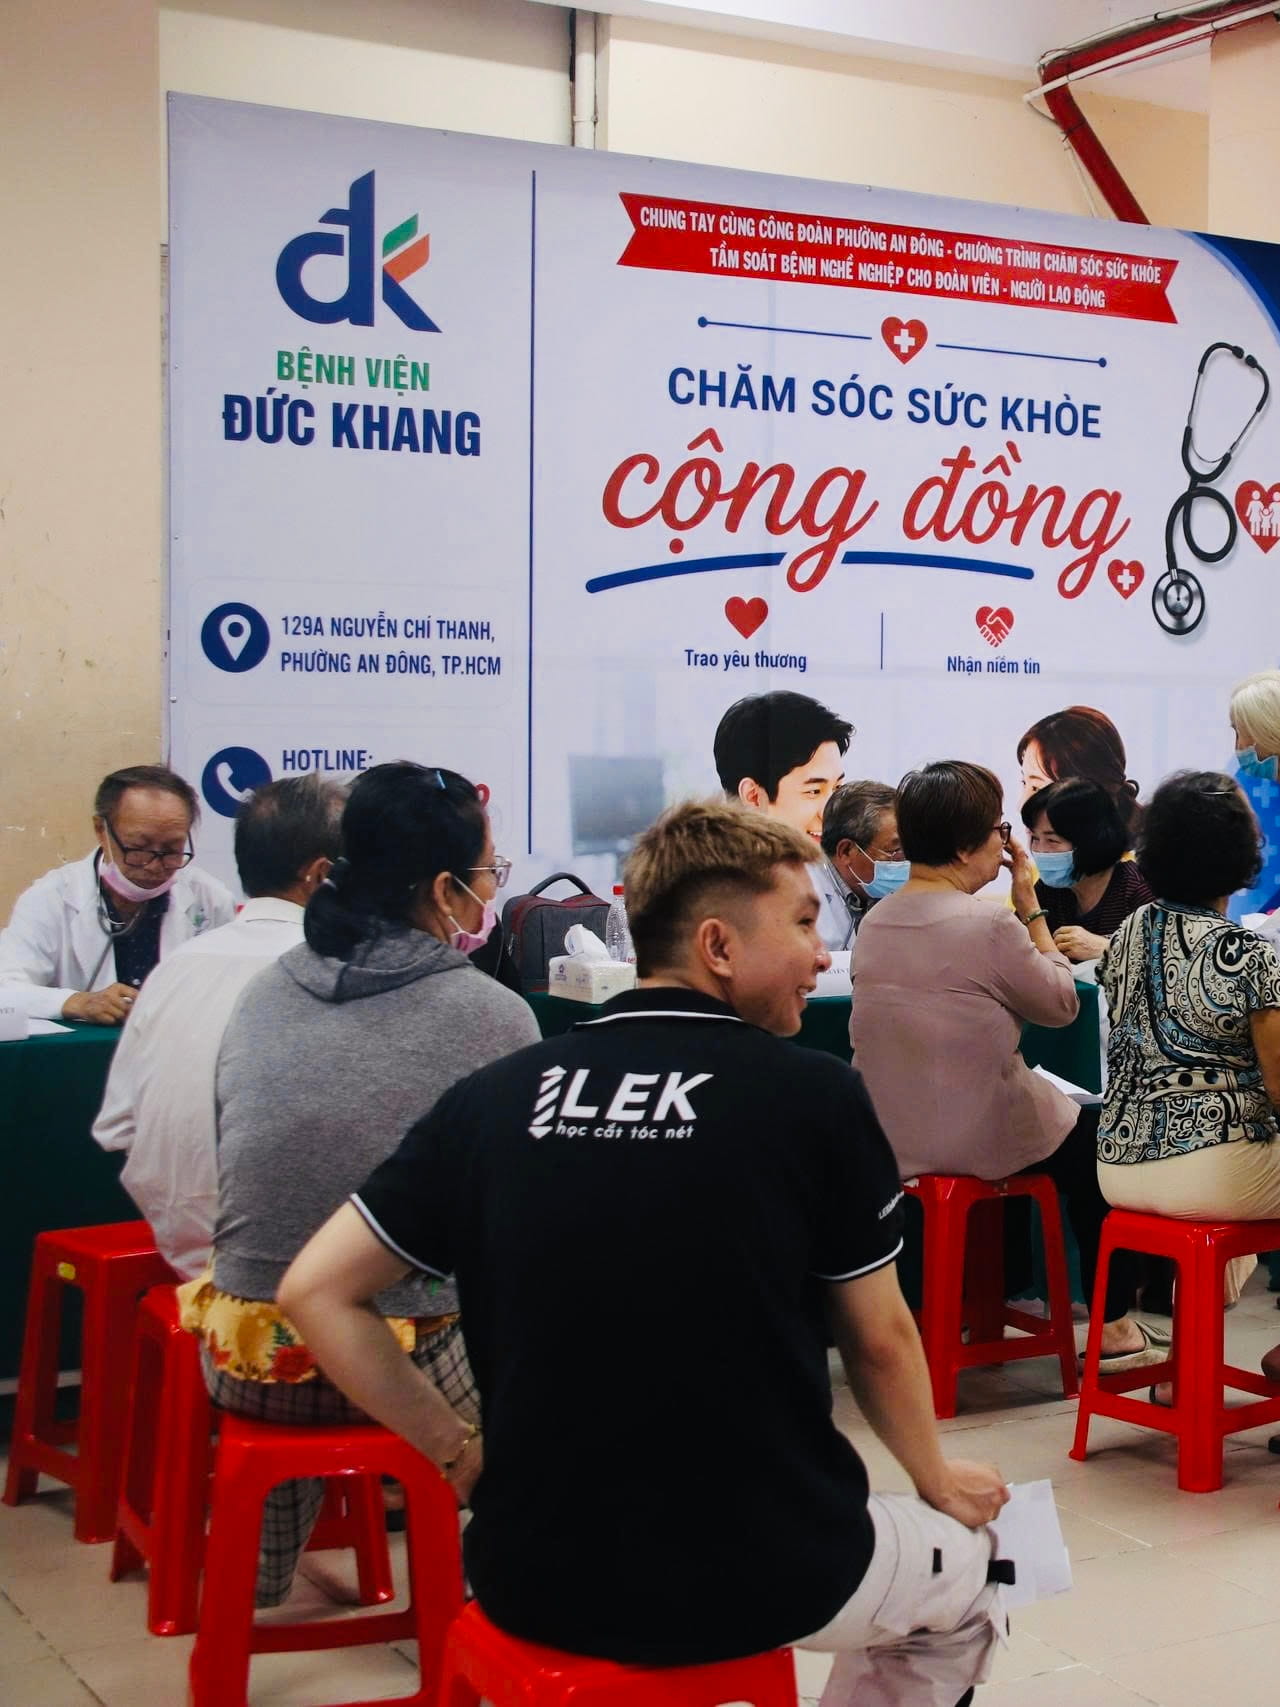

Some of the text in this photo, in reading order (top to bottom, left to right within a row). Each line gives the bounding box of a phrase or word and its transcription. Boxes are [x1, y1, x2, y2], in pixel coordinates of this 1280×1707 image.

[639, 206, 687, 231] CHUNG
[690, 211, 716, 233] TAY
[719, 211, 755, 237] CÙNG
[758, 215, 794, 241] CÔNG
[797, 220, 833, 245] ĐOÀN
[836, 226, 887, 251] PHƯỜNG
[890, 233, 907, 253] AN
[910, 232, 944, 258] ĐÔNG
[954, 241, 1003, 265] CHƯƠNG
[1005, 245, 1041, 269] TRÌNH
[1043, 251, 1078, 274] CHĂM
[1080, 252, 1103, 277] SÓC
[1105, 256, 1129, 281] SỨC
[1131, 258, 1162, 284] KHỎE
[710, 240, 740, 270] TẦM
[743, 247, 777, 273] SOÁT
[780, 250, 817, 278] BỆNH
[820, 253, 854, 280] NGHỀ
[858, 260, 905, 288] NGHIỆP
[906, 267, 932, 289] CHO
[935, 270, 969, 292] ĐOÀN
[971, 274, 1000, 296] VIÊN
[1010, 277, 1046, 301] NGƯỜI
[1048, 284, 1071, 305] LAO
[1074, 284, 1106, 310] ĐỘNG
[276, 346, 430, 397] BỆNH VIỆN
[667, 362, 797, 413] CHĂM
[811, 373, 894, 421] SÓC
[906, 382, 988, 429] SỨC
[221, 386, 481, 457] ĐỨC KHANG
[601, 427, 1131, 600] cộng đồng
[281, 610, 496, 643] 129A NGUYỄN CHÍ THANH,
[281, 650, 502, 677] PHƯỜNG AN ĐÔNG, TP.HCM
[685, 649, 807, 673] Trao yêu thương
[947, 654, 982, 676] Nhận
[1023, 656, 1041, 675] tin
[282, 749, 374, 771] HOTLINE:
[555, 1119, 696, 1140] học cắt tóc nét
